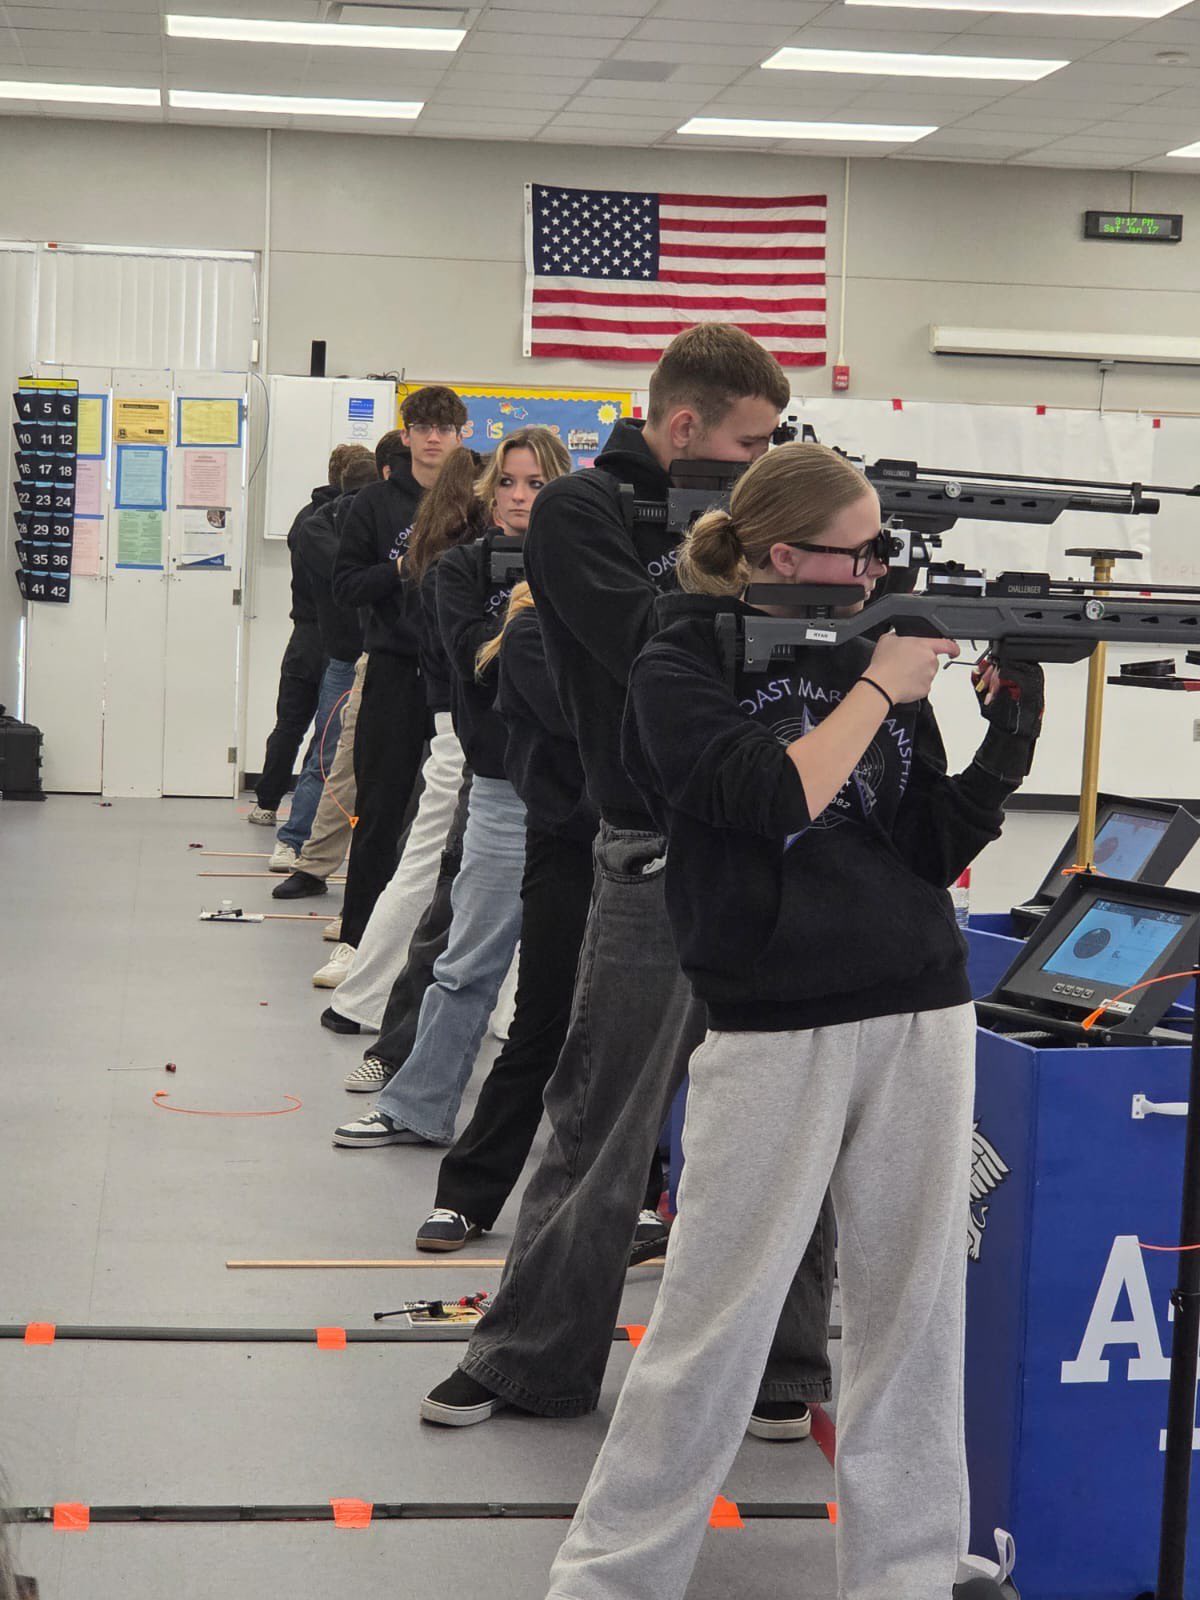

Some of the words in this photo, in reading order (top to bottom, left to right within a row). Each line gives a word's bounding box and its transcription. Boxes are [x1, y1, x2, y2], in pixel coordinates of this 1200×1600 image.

[1142, 217, 1154, 227] PM
[1103, 223, 1121, 233] Sat
[1126, 225, 1142, 234] Jan
[1148, 225, 1160, 235] 17
[23, 402, 31, 413] 4
[43, 402, 52, 414] 5
[62, 404, 71, 415] 6
[19, 433, 32, 444] 10
[40, 434, 53, 445] 11
[58, 434, 73, 445] 12
[19, 463, 31, 474] 16
[38, 464, 52, 475] 17
[58, 465, 73, 476] 18
[18, 492, 31, 503] 22
[35, 494, 52, 506] 23
[55, 496, 71, 507] 24
[33, 524, 49, 535] 29
[53, 525, 70, 536] 30
[32, 554, 48, 565] 35
[52, 555, 68, 566] 36
[31, 583, 45, 595] 41
[50, 586, 67, 598] 42
[1007, 584, 1041, 594] CHALLENGER
[739, 678, 792, 716] OAST
